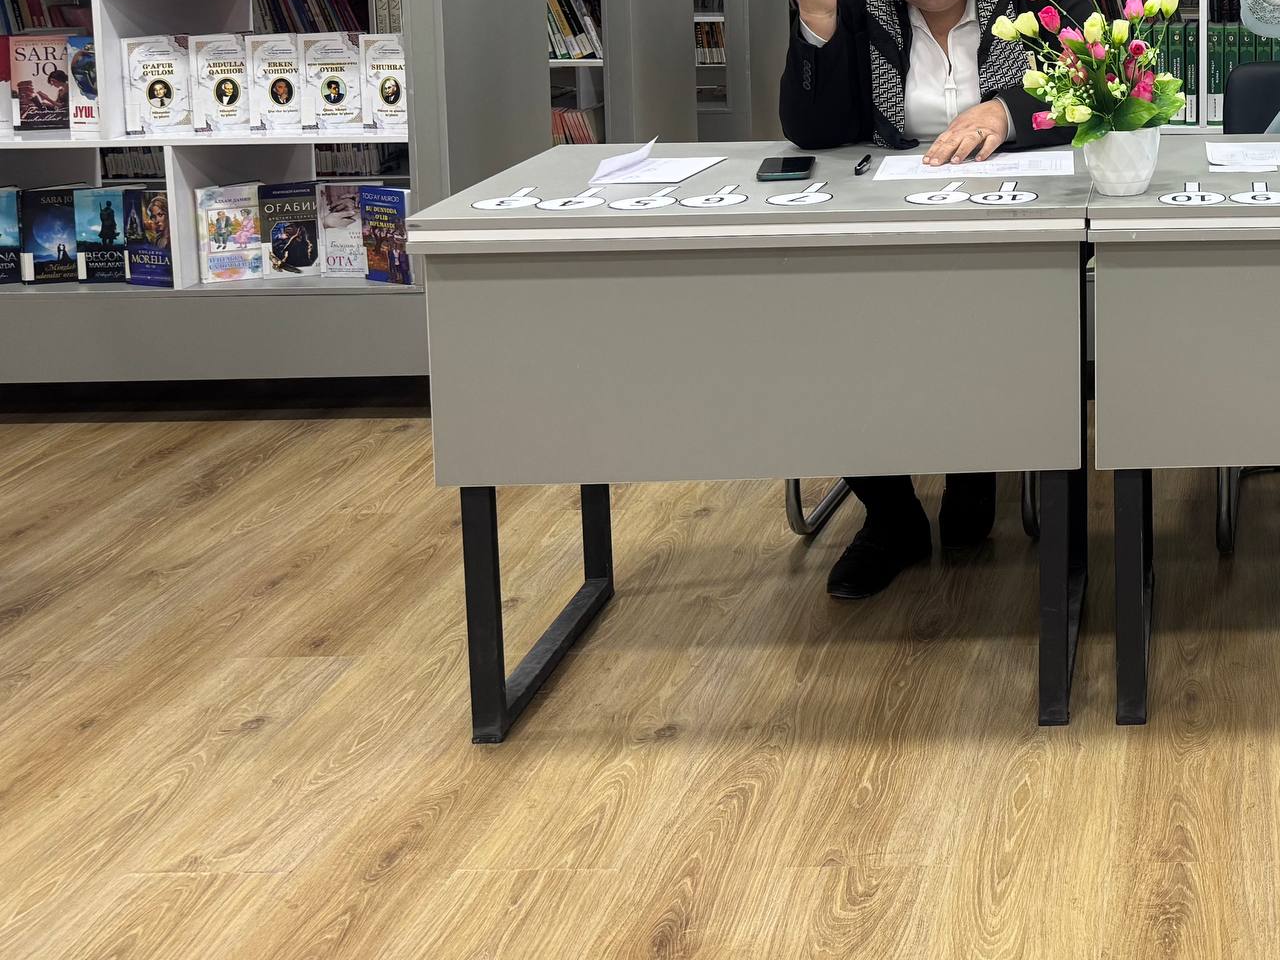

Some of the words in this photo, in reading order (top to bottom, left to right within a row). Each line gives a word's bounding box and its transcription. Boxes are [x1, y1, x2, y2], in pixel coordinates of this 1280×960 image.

[206, 61, 245, 69] ABDULLA
[73, 105, 95, 119] JYUL
[131, 254, 170, 265] MORELLA
